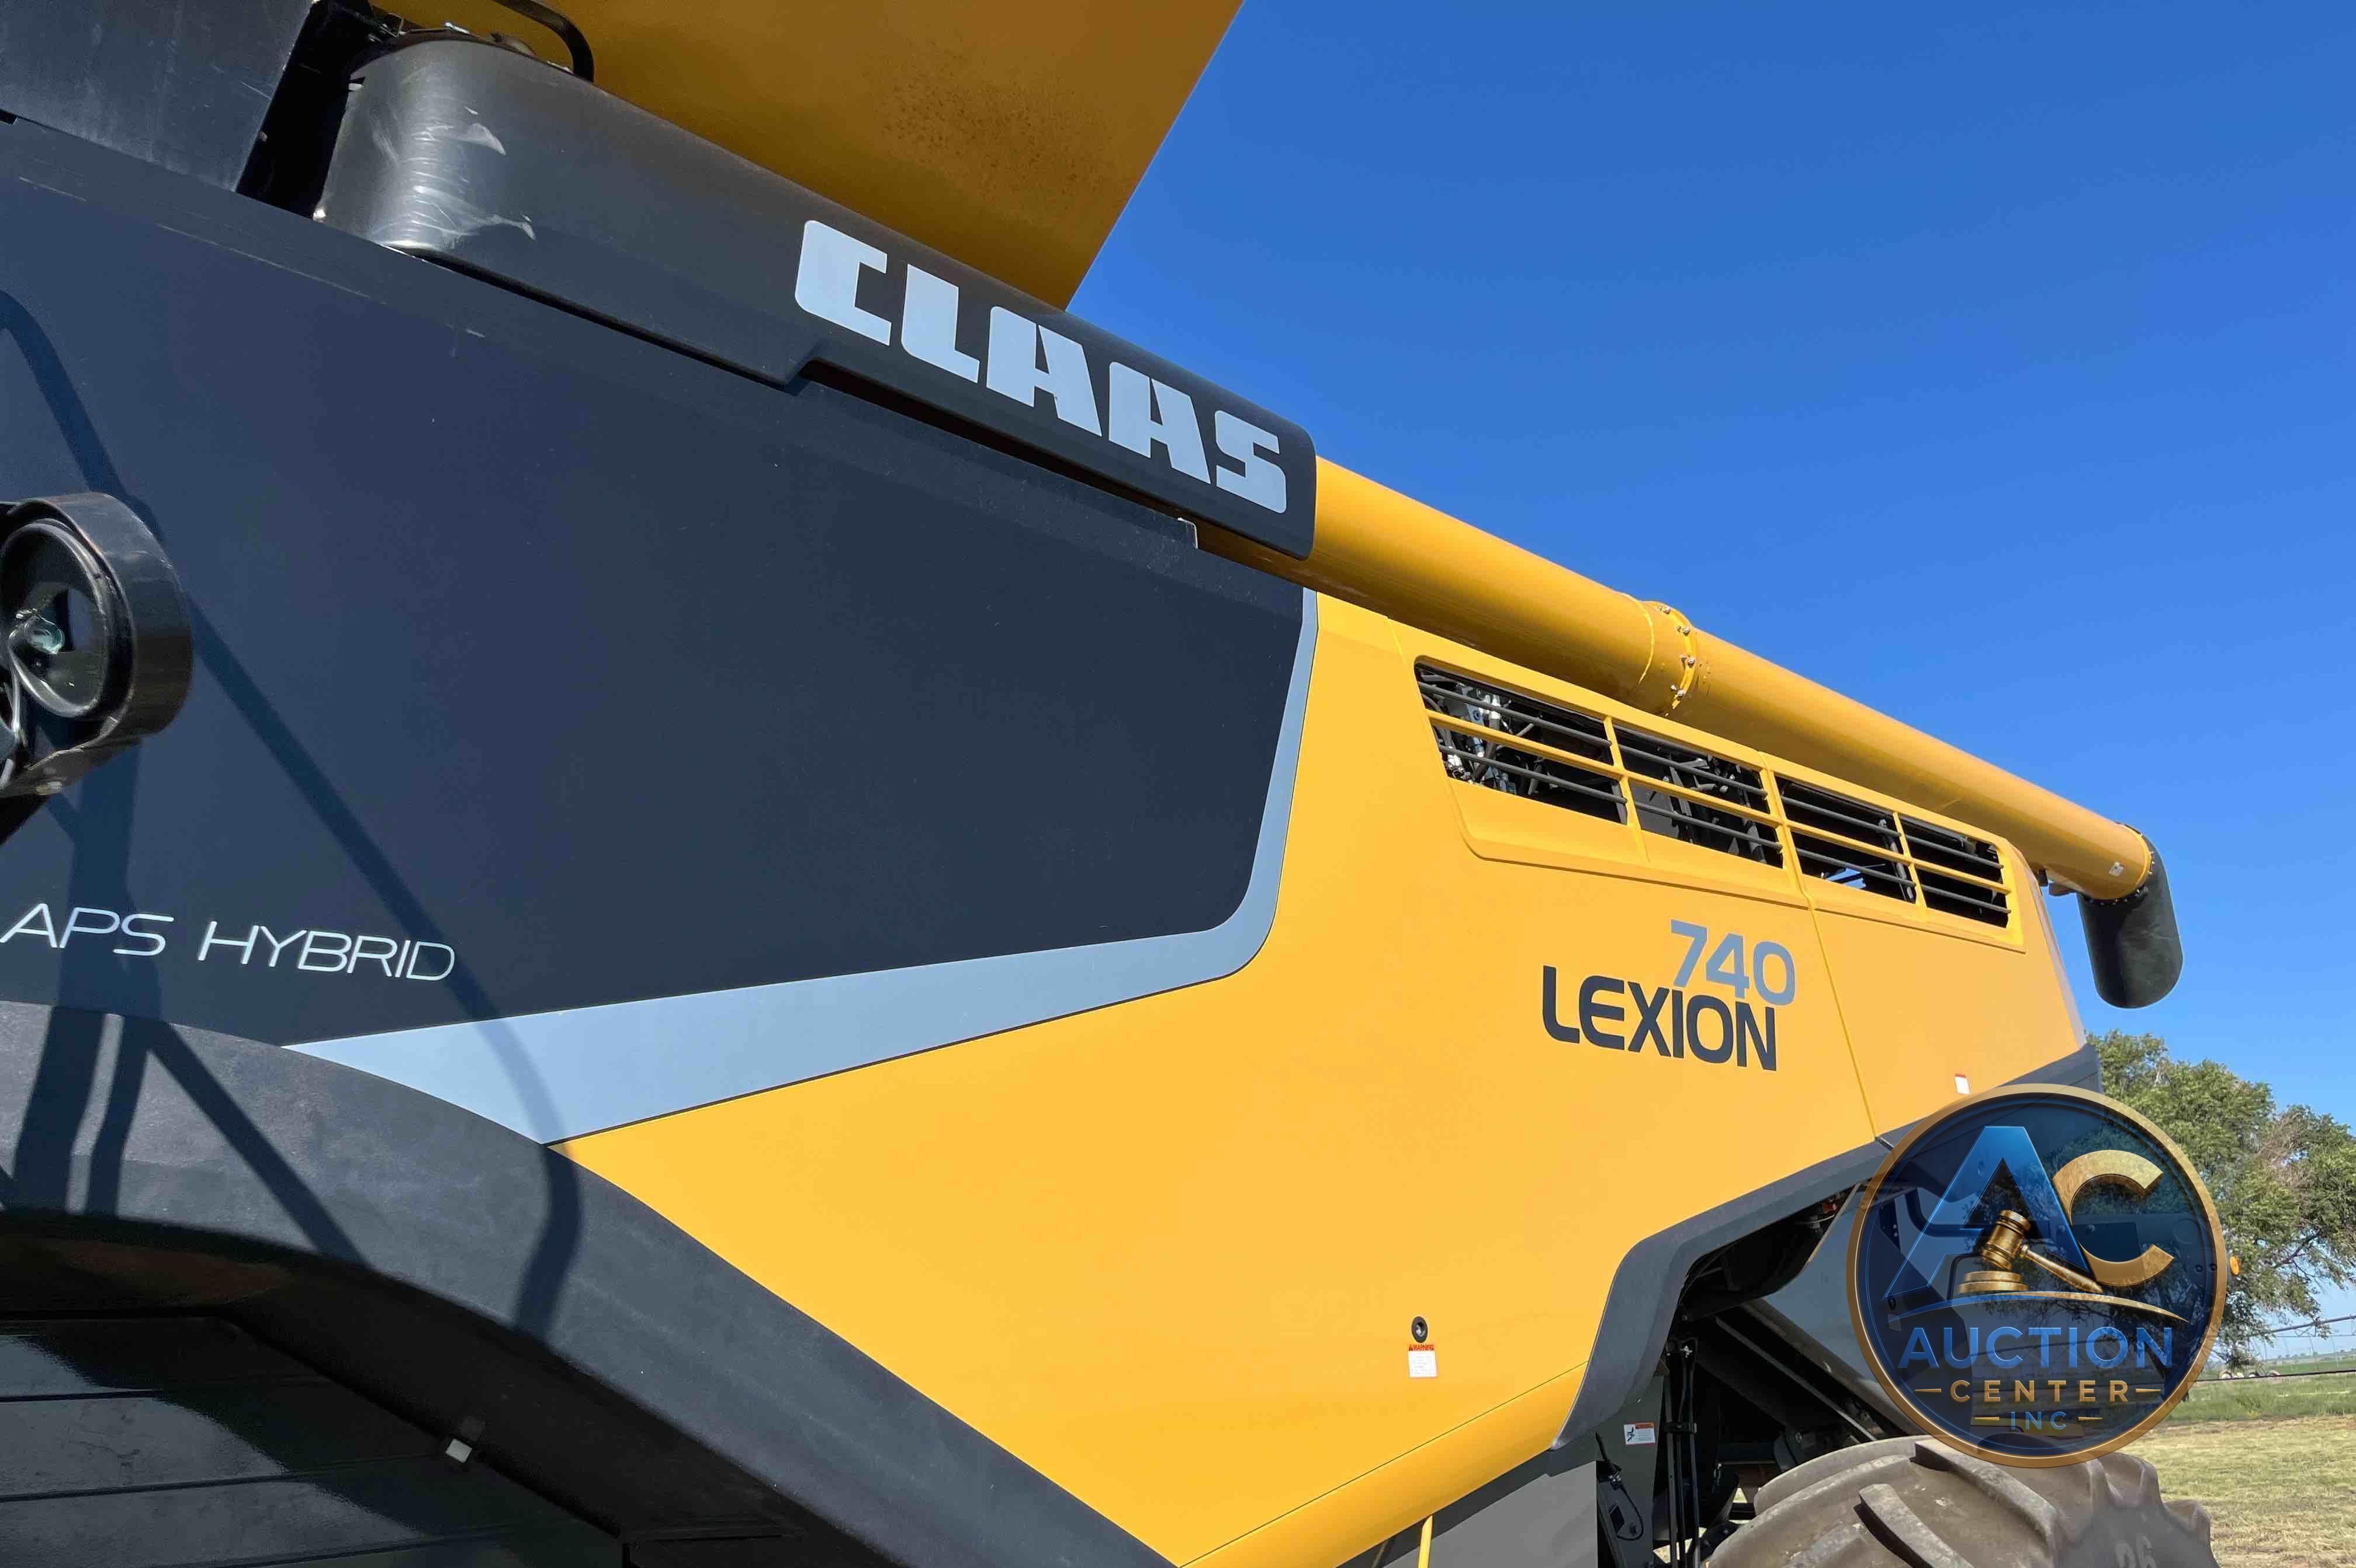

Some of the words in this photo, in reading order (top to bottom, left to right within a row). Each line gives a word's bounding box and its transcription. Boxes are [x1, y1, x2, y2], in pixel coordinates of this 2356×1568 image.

[795, 220, 1286, 514] CLAAS
[0, 903, 174, 956] APS
[198, 921, 455, 980] HYBRID
[1670, 919, 1796, 1005] 740
[1543, 965, 1776, 1071] LEXION
